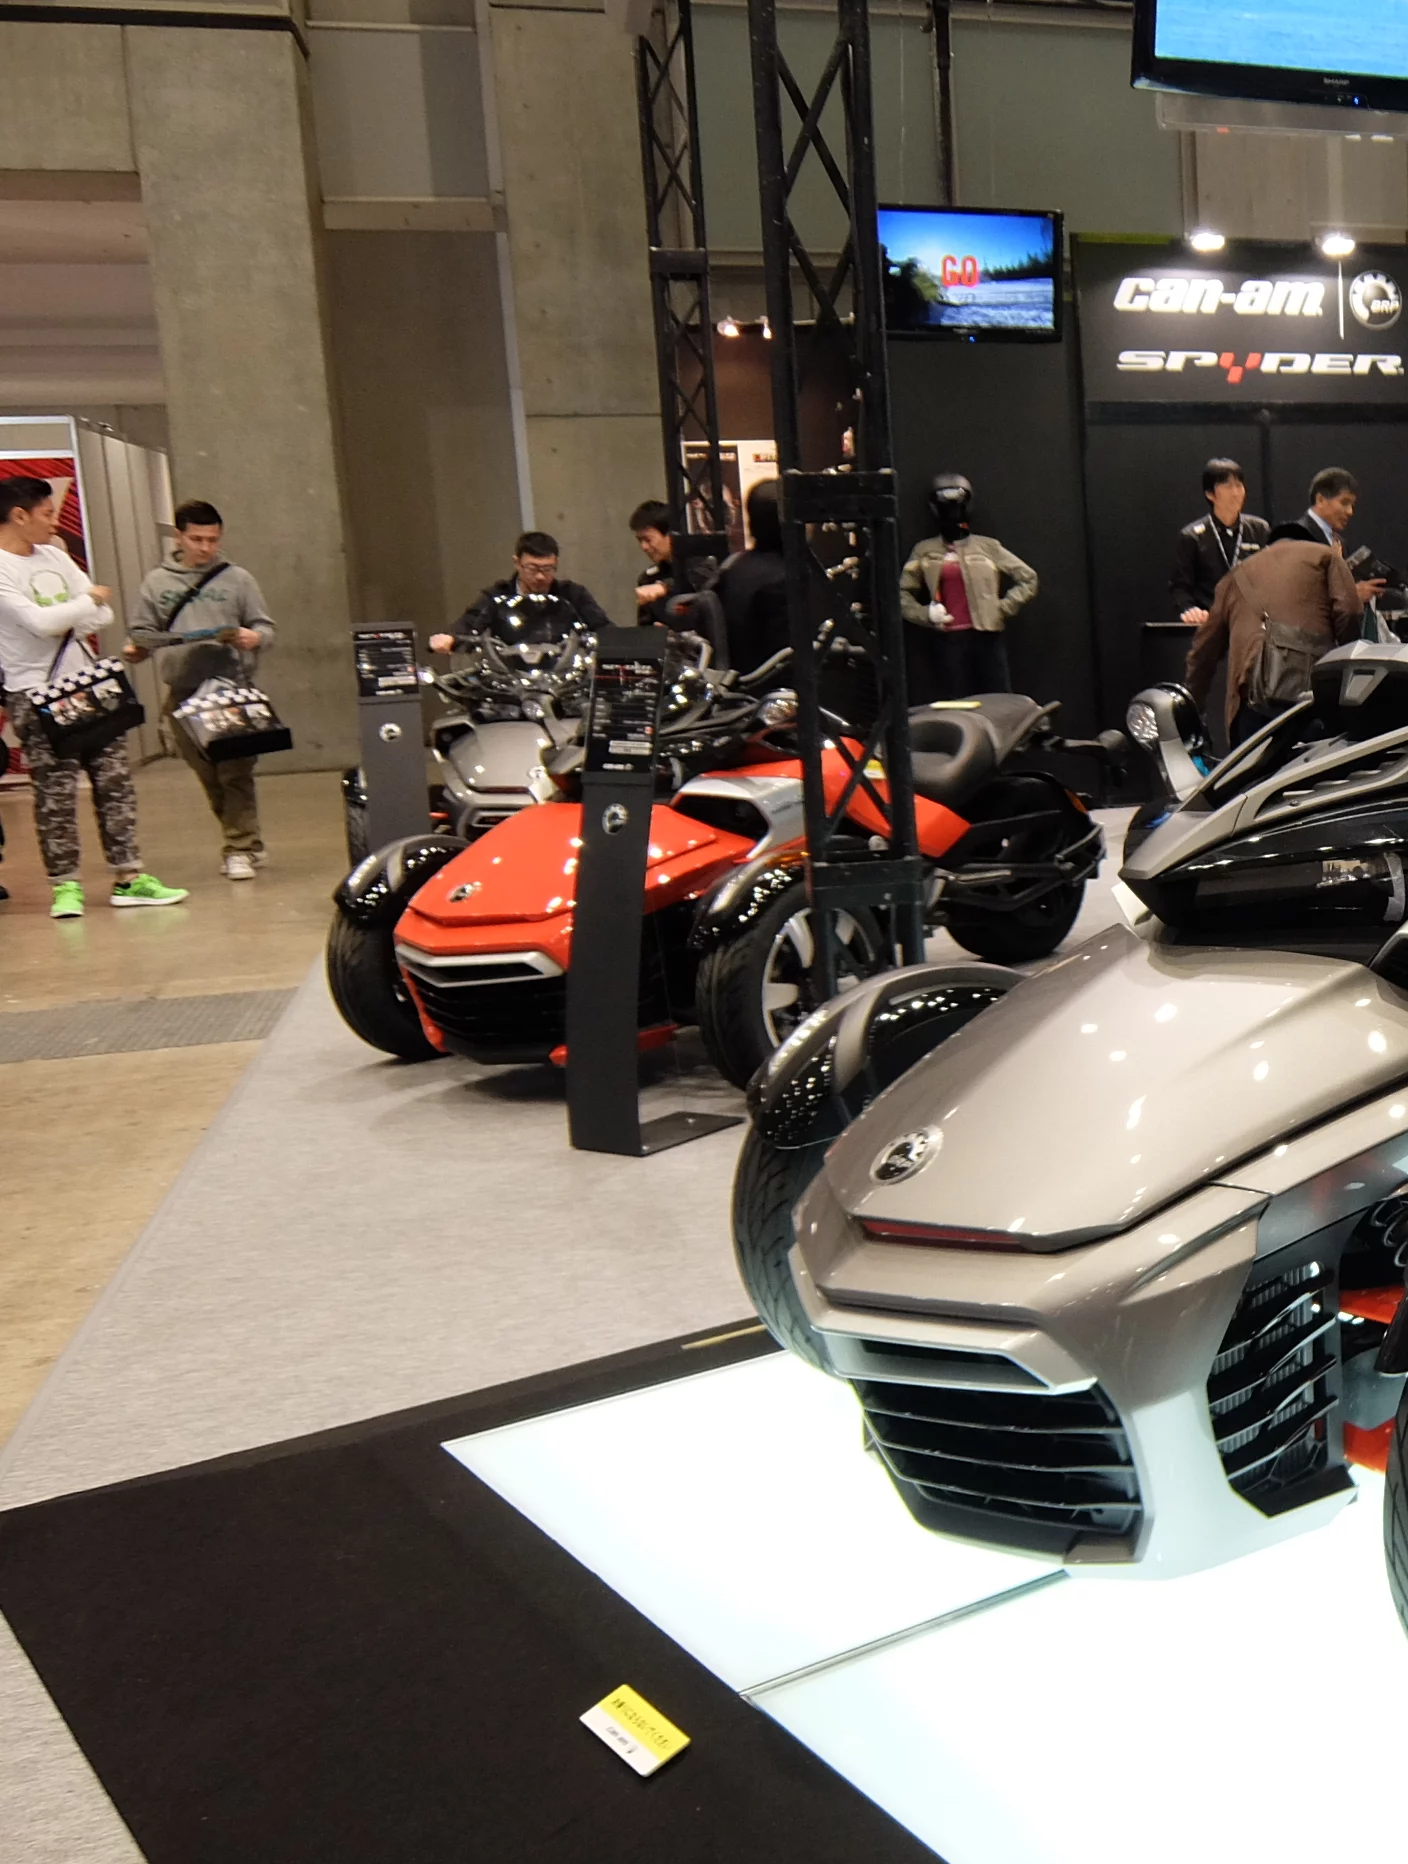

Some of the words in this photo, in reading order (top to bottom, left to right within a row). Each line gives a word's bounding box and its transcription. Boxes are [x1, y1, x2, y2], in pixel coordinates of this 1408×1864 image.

[941, 255, 979, 288] GO
[1370, 298, 1400, 315] BRP
[1116, 350, 1404, 384] SPYDER
